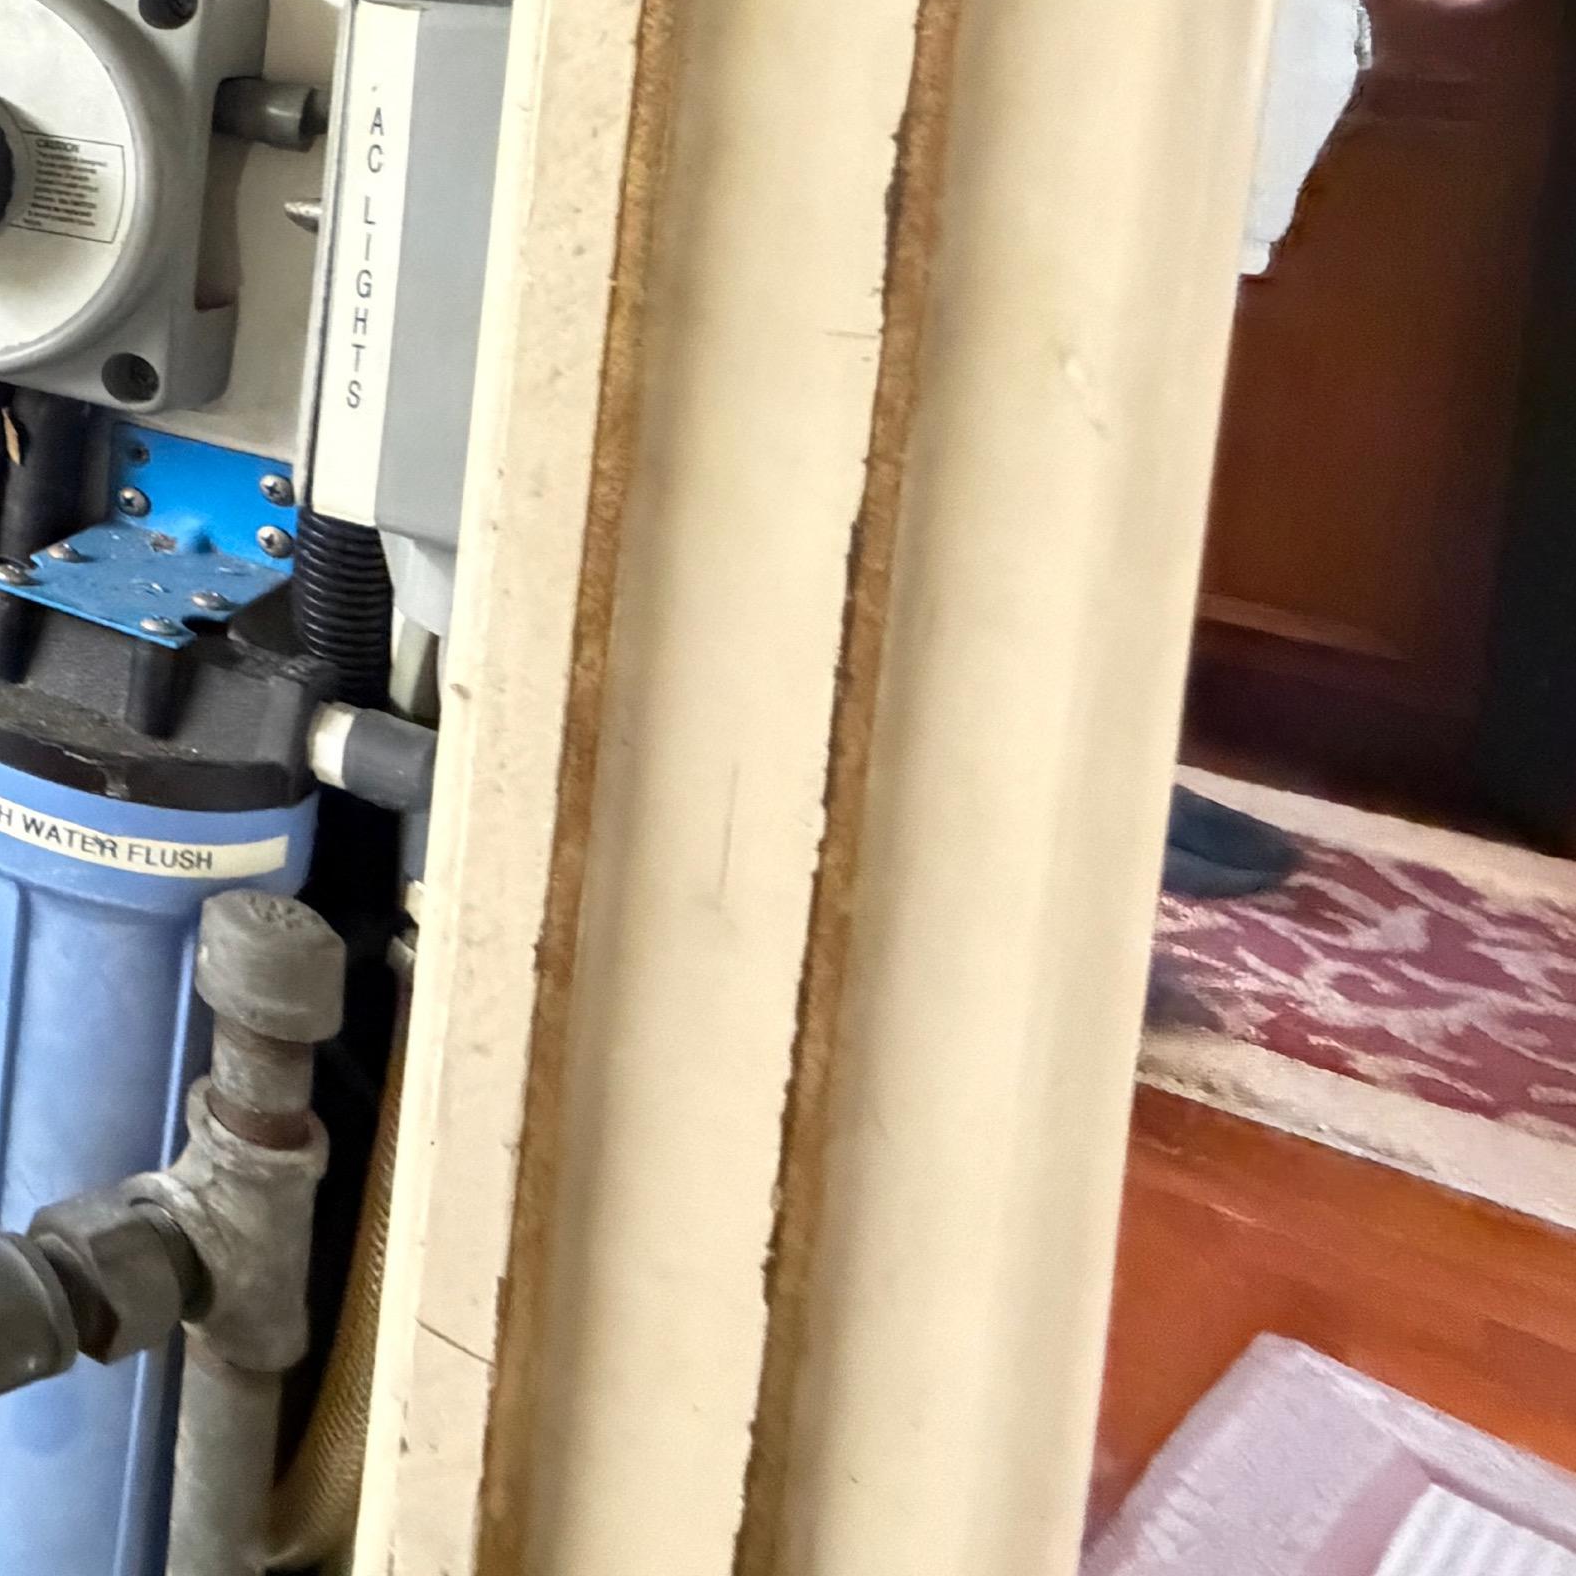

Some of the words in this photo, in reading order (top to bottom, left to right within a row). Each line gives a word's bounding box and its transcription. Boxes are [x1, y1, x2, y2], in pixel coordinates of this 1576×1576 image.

[367, 106, 385, 174] AC
[346, 194, 375, 410] LIGHTS
[21, 813, 118, 858] WATER
[127, 845, 213, 871] FLUSH
